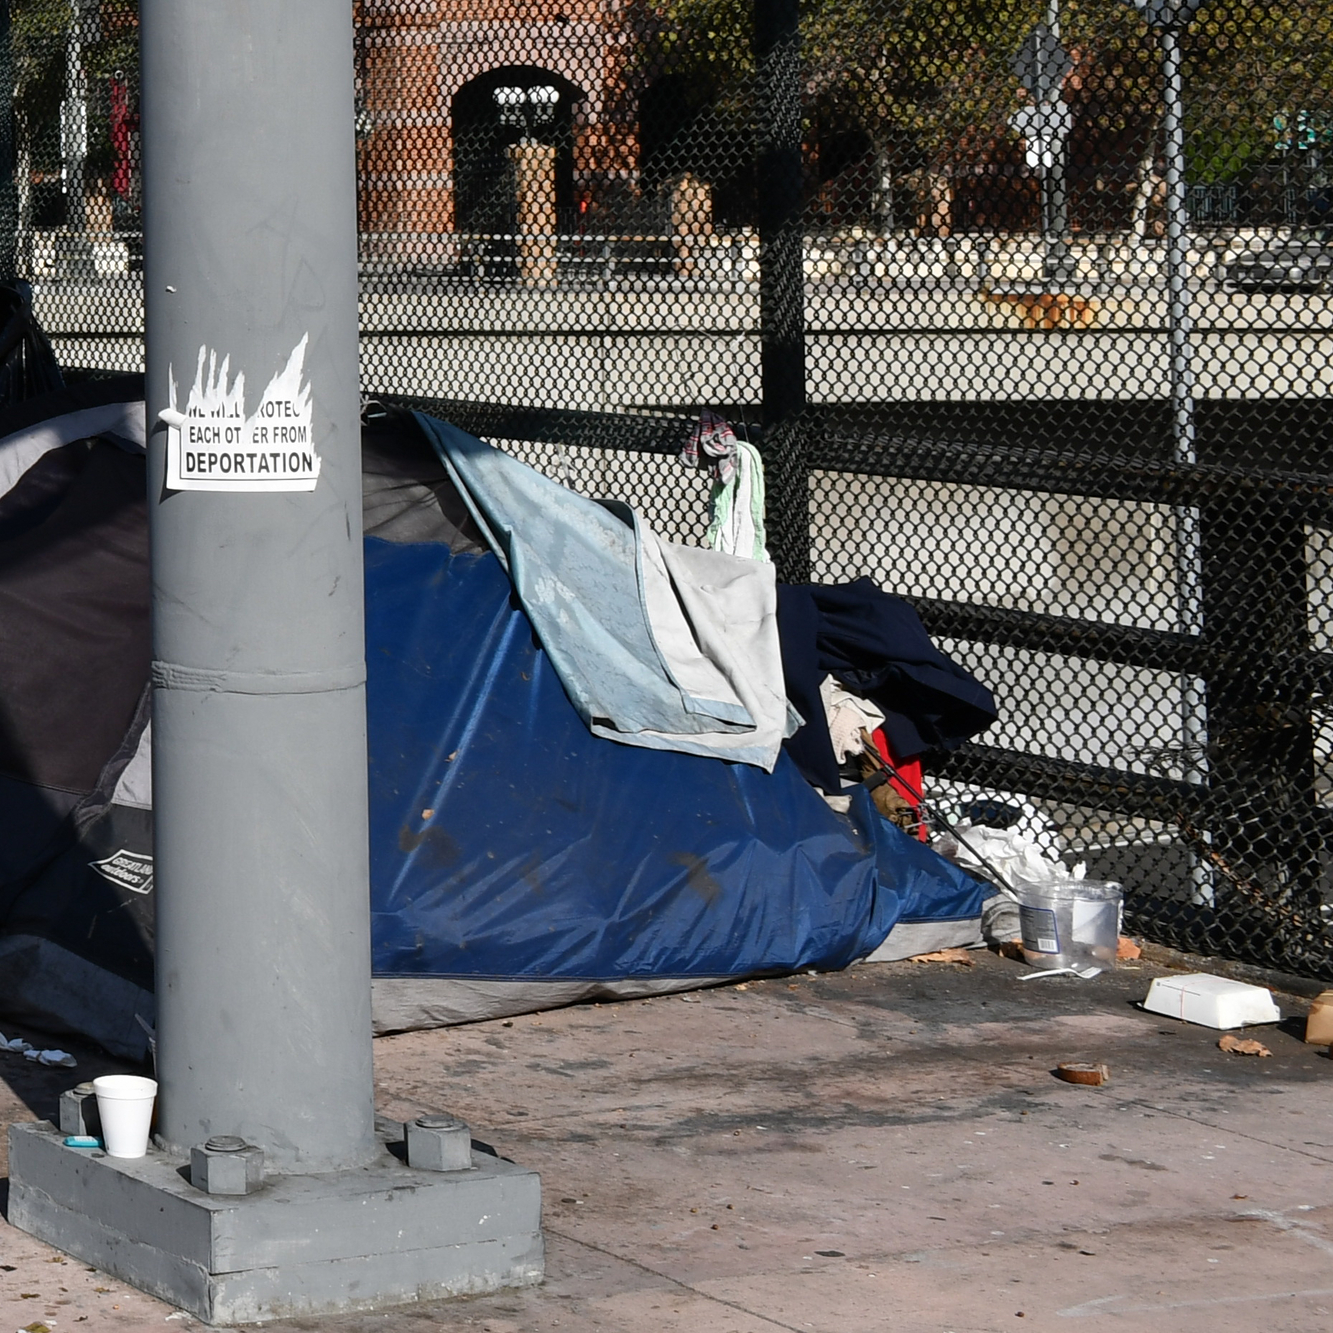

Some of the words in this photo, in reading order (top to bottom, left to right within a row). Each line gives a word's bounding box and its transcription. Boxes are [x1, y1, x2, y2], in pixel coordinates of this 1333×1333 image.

[189, 426, 221, 444] EACH
[225, 426, 269, 444] OTER
[273, 425, 307, 444] FROM
[186, 452, 313, 474] DEPORTATION
